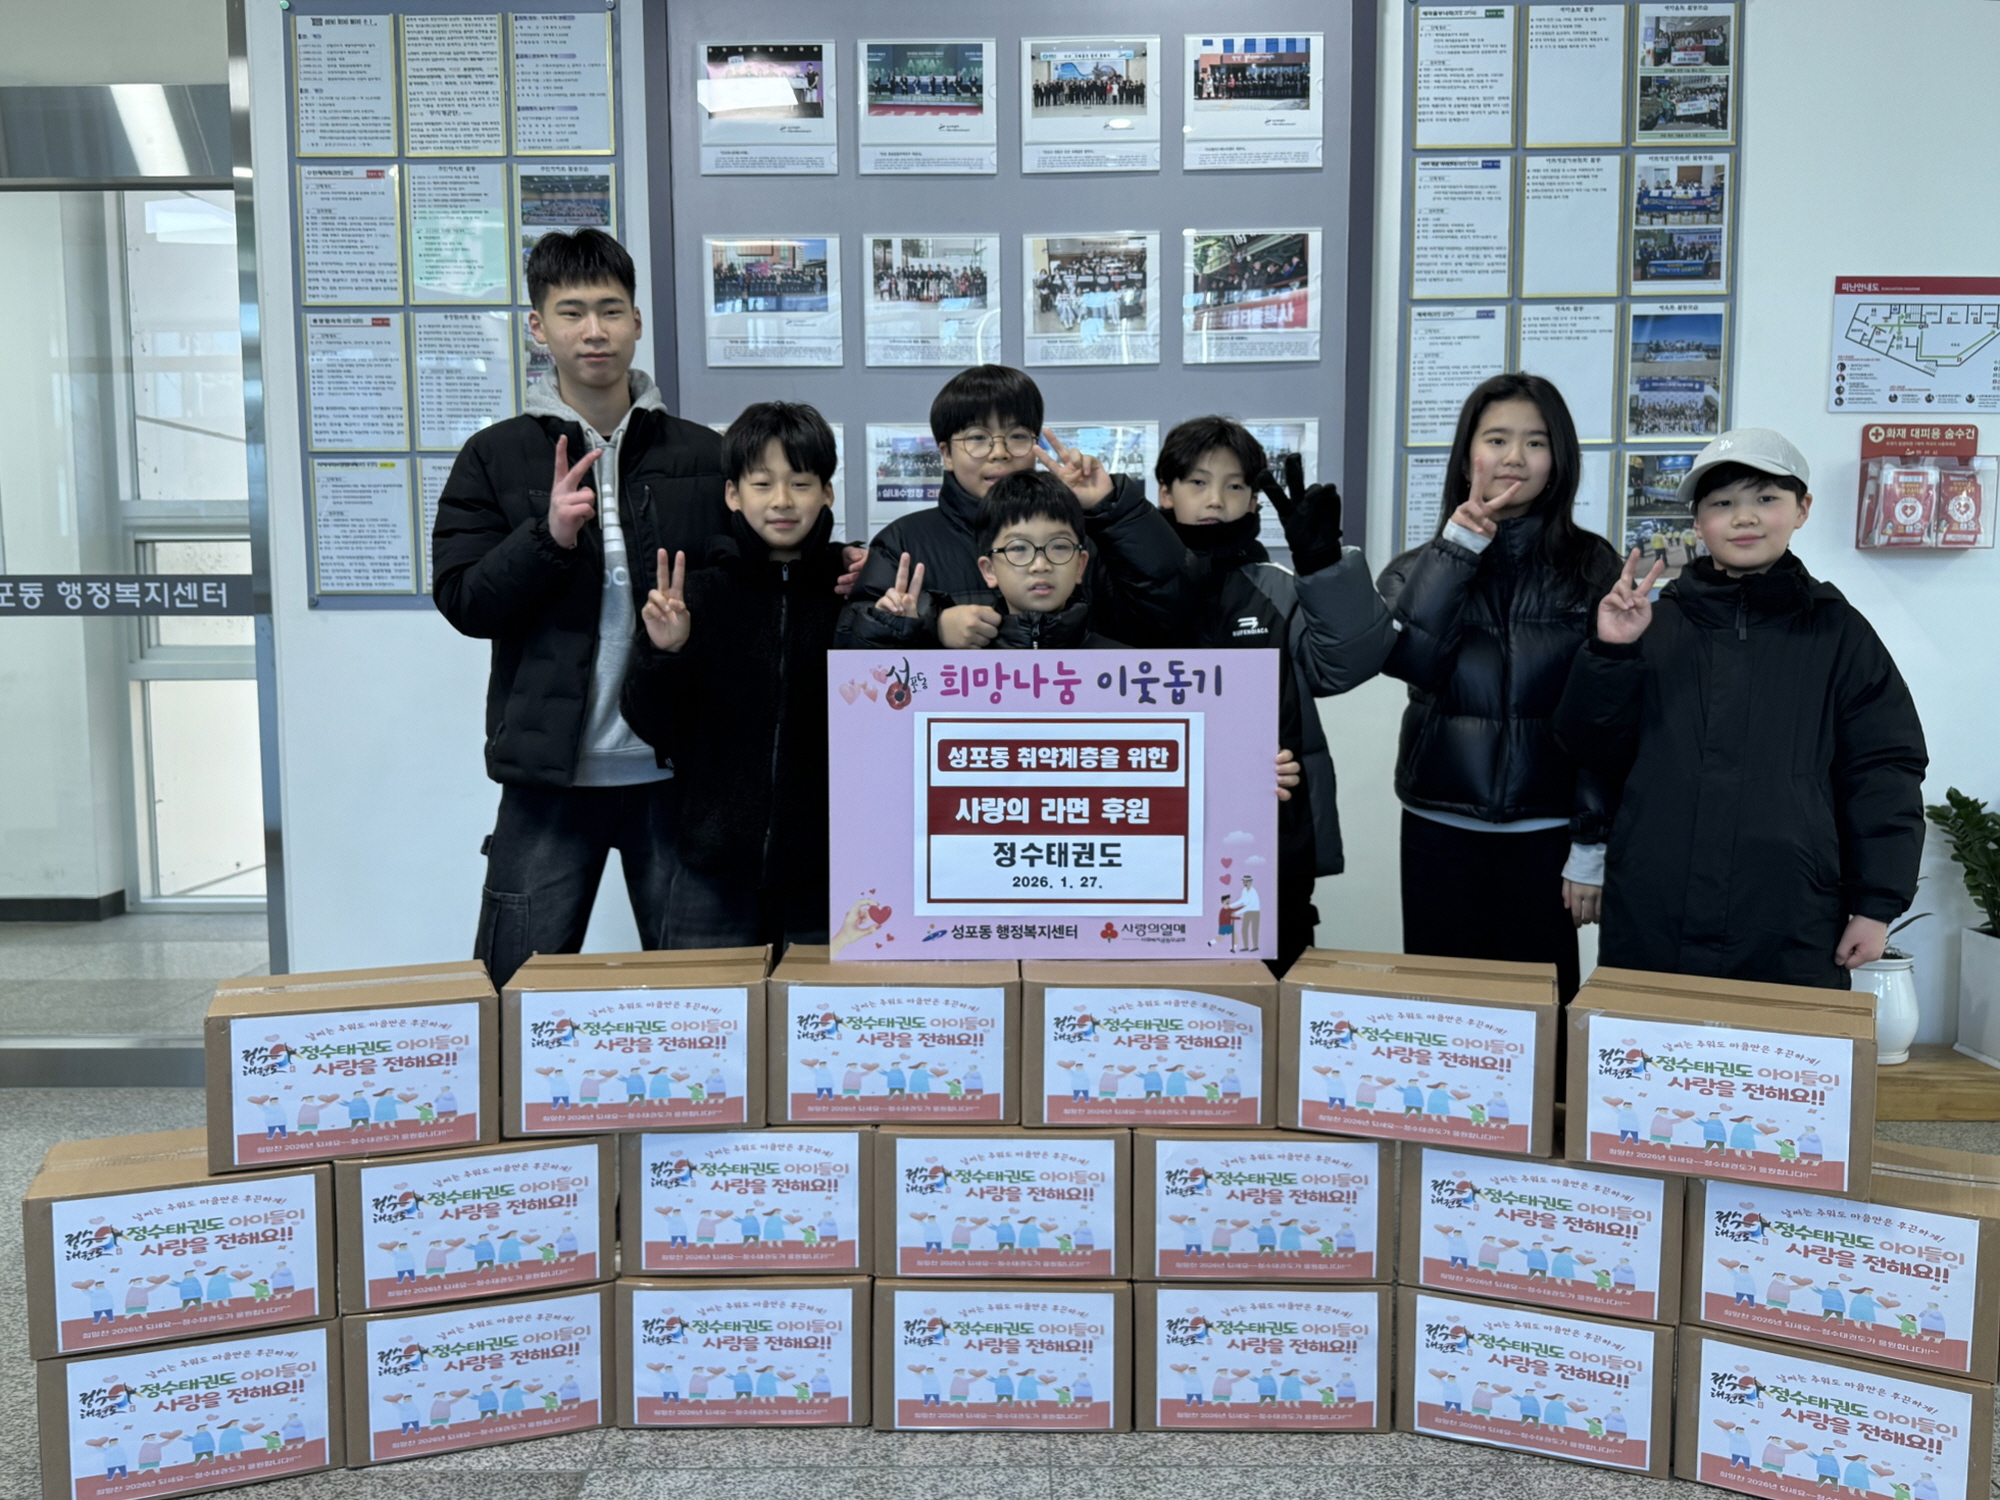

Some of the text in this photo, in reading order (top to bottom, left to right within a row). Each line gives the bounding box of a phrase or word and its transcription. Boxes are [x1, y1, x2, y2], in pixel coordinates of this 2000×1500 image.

[1841, 282, 1879, 292] 피난안내도
[1885, 427, 1906, 440] 화재
[1910, 427, 1941, 440] 대피용
[882, 488, 924, 498] 실내수영장
[57, 581, 227, 609] 행정복지센터
[940, 660, 1223, 705] 희망나눔 이웃돕기
[948, 746, 1169, 769] 성포동 취약계층을 위한
[955, 797, 1150, 825] 사랑의 라면 후원
[992, 842, 1123, 869] 정수태권도
[1012, 876, 1103, 889] 2026. 1. 27.
[951, 924, 1078, 940] 성포동 행정복지센터
[1121, 922, 1187, 938] 사랑의열매
[583, 1019, 737, 1037] 정수태권도 아이들이
[846, 1016, 994, 1030] 정수태권도 아이들이
[1103, 1018, 1252, 1033] 정수태권도 아이들이
[300, 1035, 468, 1061] 정수태권도 아이들이
[593, 1035, 726, 1054] 사랑을 전해요!!
[856, 1032, 984, 1048] 사랑을 전해요!!
[1113, 1034, 1241, 1051] 사랑을 전해요!!
[1361, 1026, 1524, 1055] 정수태권도 아이들이
[1662, 1039, 1820, 1066] 날씨는 추워도 마음만은 후끈하게!
[312, 1052, 457, 1077] 사랑을 전해요!!
[1371, 1046, 1511, 1073] 사랑을 전해요!!
[1656, 1055, 1840, 1087] 정수태권도 아이들이
[1667, 1076, 1825, 1106] 사랑을 전해요!!
[1635, 1149, 1667, 1162] 2026년
[700, 1162, 849, 1177] 정수태권도 아이들이
[955, 1169, 1105, 1184] 정수태권도 아이들이
[1216, 1171, 1368, 1187] 정수태권도 아이들이
[428, 1176, 588, 1207] 정수태권도 아이들이
[710, 1178, 838, 1195] 사랑을 전해요!!
[965, 1186, 1094, 1202] 사랑을 전해요!!
[1225, 1188, 1357, 1205] 사랑을 전해요!!
[439, 1193, 577, 1221] 사랑을 전해요!!
[1484, 1188, 1651, 1223] 정수태권도 아이들이
[127, 1208, 305, 1242] 정수태권도 아이들이
[1494, 1208, 1638, 1240] 사랑을 전해요!!
[1781, 1209, 1945, 1244] 날씨는 추워도 마음만은 후끈하게!
[140, 1226, 293, 1257] 사랑을 전해요!!
[1774, 1221, 1964, 1266] 정수태권도 아이들이
[1785, 1243, 1949, 1284] 사랑을 전해요!!
[692, 1319, 842, 1334] 정수태권도 아이들이
[954, 1321, 1104, 1336] 정수태권도 아이들이
[1216, 1320, 1368, 1336] 정수태권도 아이들이
[1750, 1312, 1783, 1327] 2026년
[432, 1325, 591, 1359] 정수태권도 아이들이
[702, 1335, 831, 1352] 사랑을 전해요!!
[963, 1338, 1093, 1355] 사랑을 전해요!!
[1226, 1337, 1357, 1354] 사랑을 전해요!!
[1478, 1334, 1641, 1373] 정수태권도 아이들이
[443, 1342, 580, 1372] 사랑을 전해요!!
[141, 1361, 316, 1399] 정수태권도 아이들이
[1487, 1353, 1629, 1389] 사랑을 전해요!!
[153, 1378, 304, 1413] 사랑을 전해요!!
[1769, 1385, 1957, 1438] 정수태권도 아이들이
[1780, 1408, 1942, 1455] 사랑을 전해요!!
